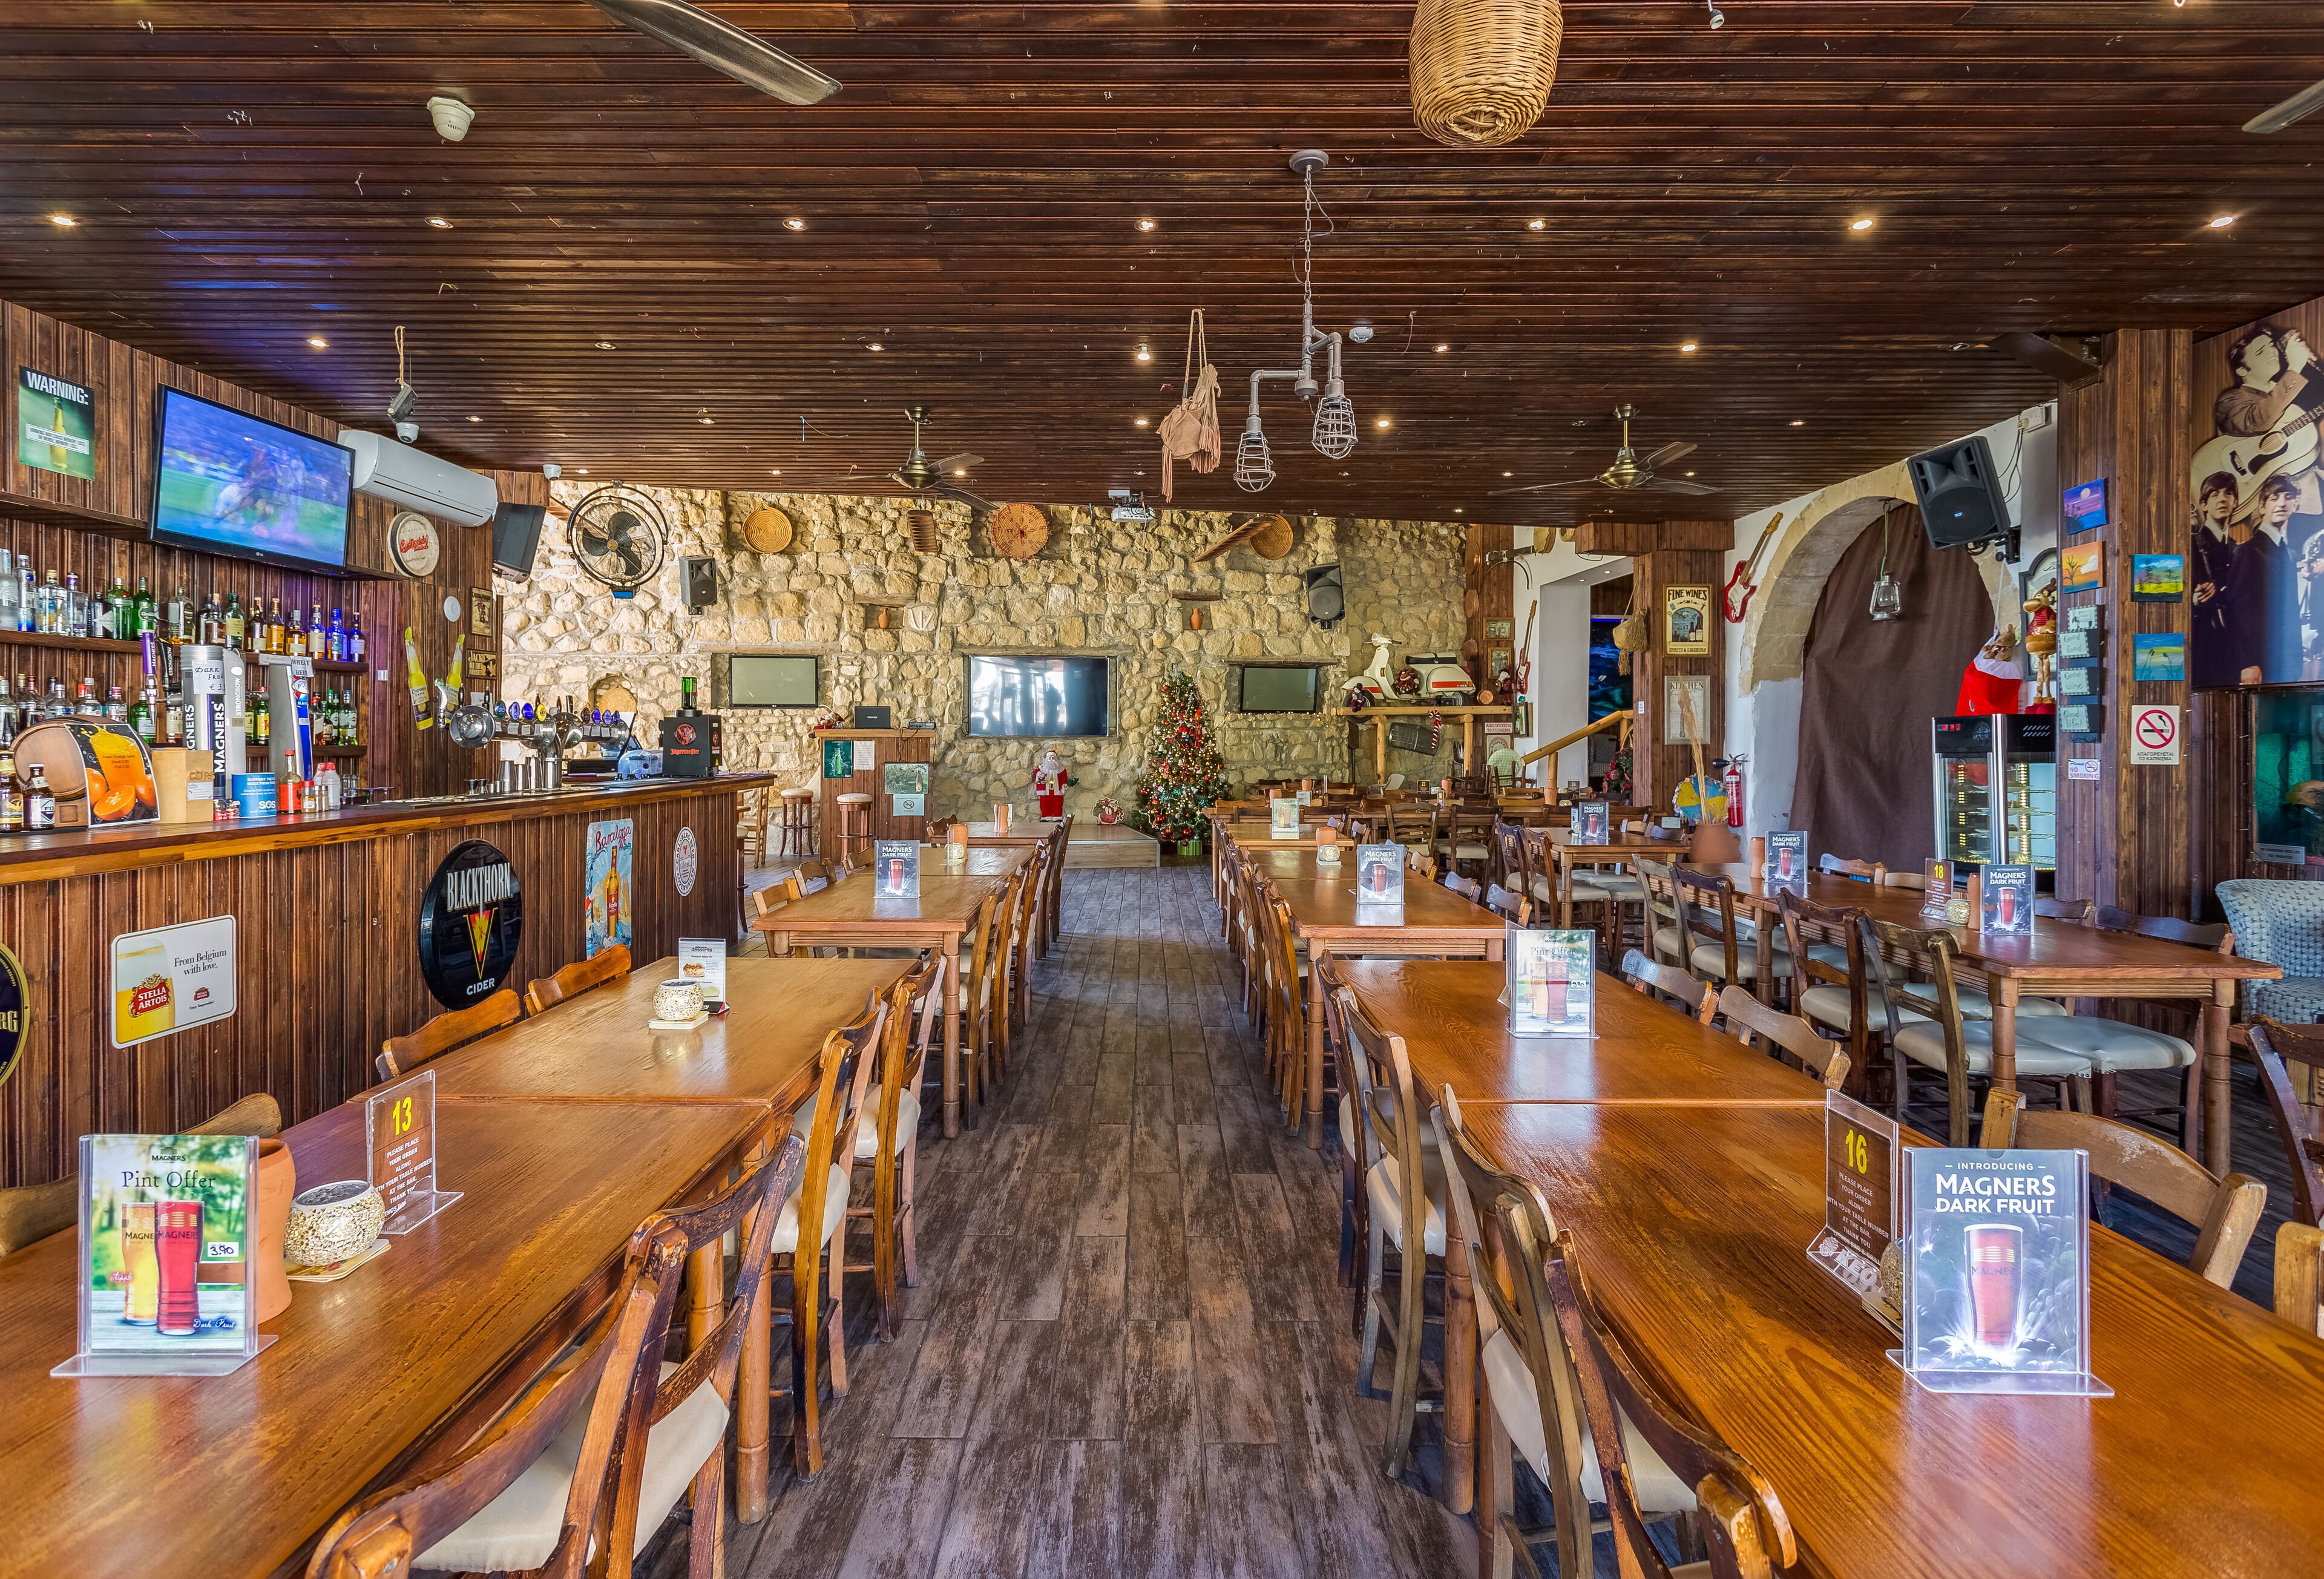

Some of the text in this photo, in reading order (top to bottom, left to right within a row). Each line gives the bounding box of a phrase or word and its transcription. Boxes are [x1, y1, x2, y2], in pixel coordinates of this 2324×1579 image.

[26, 371, 88, 405] WARNING:
[1667, 589, 1707, 601] FINE WINES
[2064, 634, 2080, 643] Good
[468, 651, 483, 662] JACK
[2067, 645, 2082, 653] food
[2066, 682, 2084, 691] wine
[2063, 709, 2079, 718] Good
[185, 704, 195, 750] GNERS
[2066, 718, 2083, 729] life!
[214, 703, 225, 773] MAGNERS
[189, 770, 215, 781] CUPS
[594, 824, 632, 855] Barcelona
[675, 832, 690, 864] CARLSBERG
[1934, 864, 1944, 879] 18
[676, 869, 694, 891] COPENHAGEN
[447, 862, 511, 916] BLACKTHORN
[174, 950, 227, 967] From Belgium
[1531, 947, 1575, 956] Pint Offer
[183, 962, 218, 976] with love.
[138, 986, 166, 1001] STELLA
[466, 977, 495, 996] CIDER
[138, 995, 167, 1009] ARTOIS
[392, 1096, 412, 1136] 13
[387, 1137, 419, 1158] PLEASE PLACE
[1845, 1128, 1868, 1174] 16
[389, 1148, 418, 1166] YOUR ORDER
[385, 1178, 398, 1190] YOUR
[399, 1170, 414, 1183] TABLE
[414, 1158, 432, 1172] NUMBER
[395, 1160, 412, 1173] ALONG
[1957, 1162, 2034, 1170] INTRODUCING
[122, 1169, 215, 1188] Pint Offer
[1839, 1172, 1873, 1197] PLEASE PLACE
[1936, 1174, 2056, 1197] MAGNERS
[396, 1183, 405, 1192] THE
[1841, 1184, 1871, 1207] YOUR ORDER
[390, 1192, 406, 1204] THANK
[1848, 1198, 1864, 1213] ALONG
[1936, 1198, 2055, 1214] DARK FRUIT
[1827, 1196, 1889, 1239] WITH YOUR TABLE NUMBER
[159, 1230, 200, 1239] MAGNERS
[1842, 1216, 1871, 1238] AT THE BAR.
[1843, 1226, 1871, 1249] THANK YOU
[209, 1246, 234, 1256] 3.90
[1834, 1249, 1877, 1286] KEO
[110, 1271, 133, 1282] Apple
[193, 1318, 212, 1328] Dark
